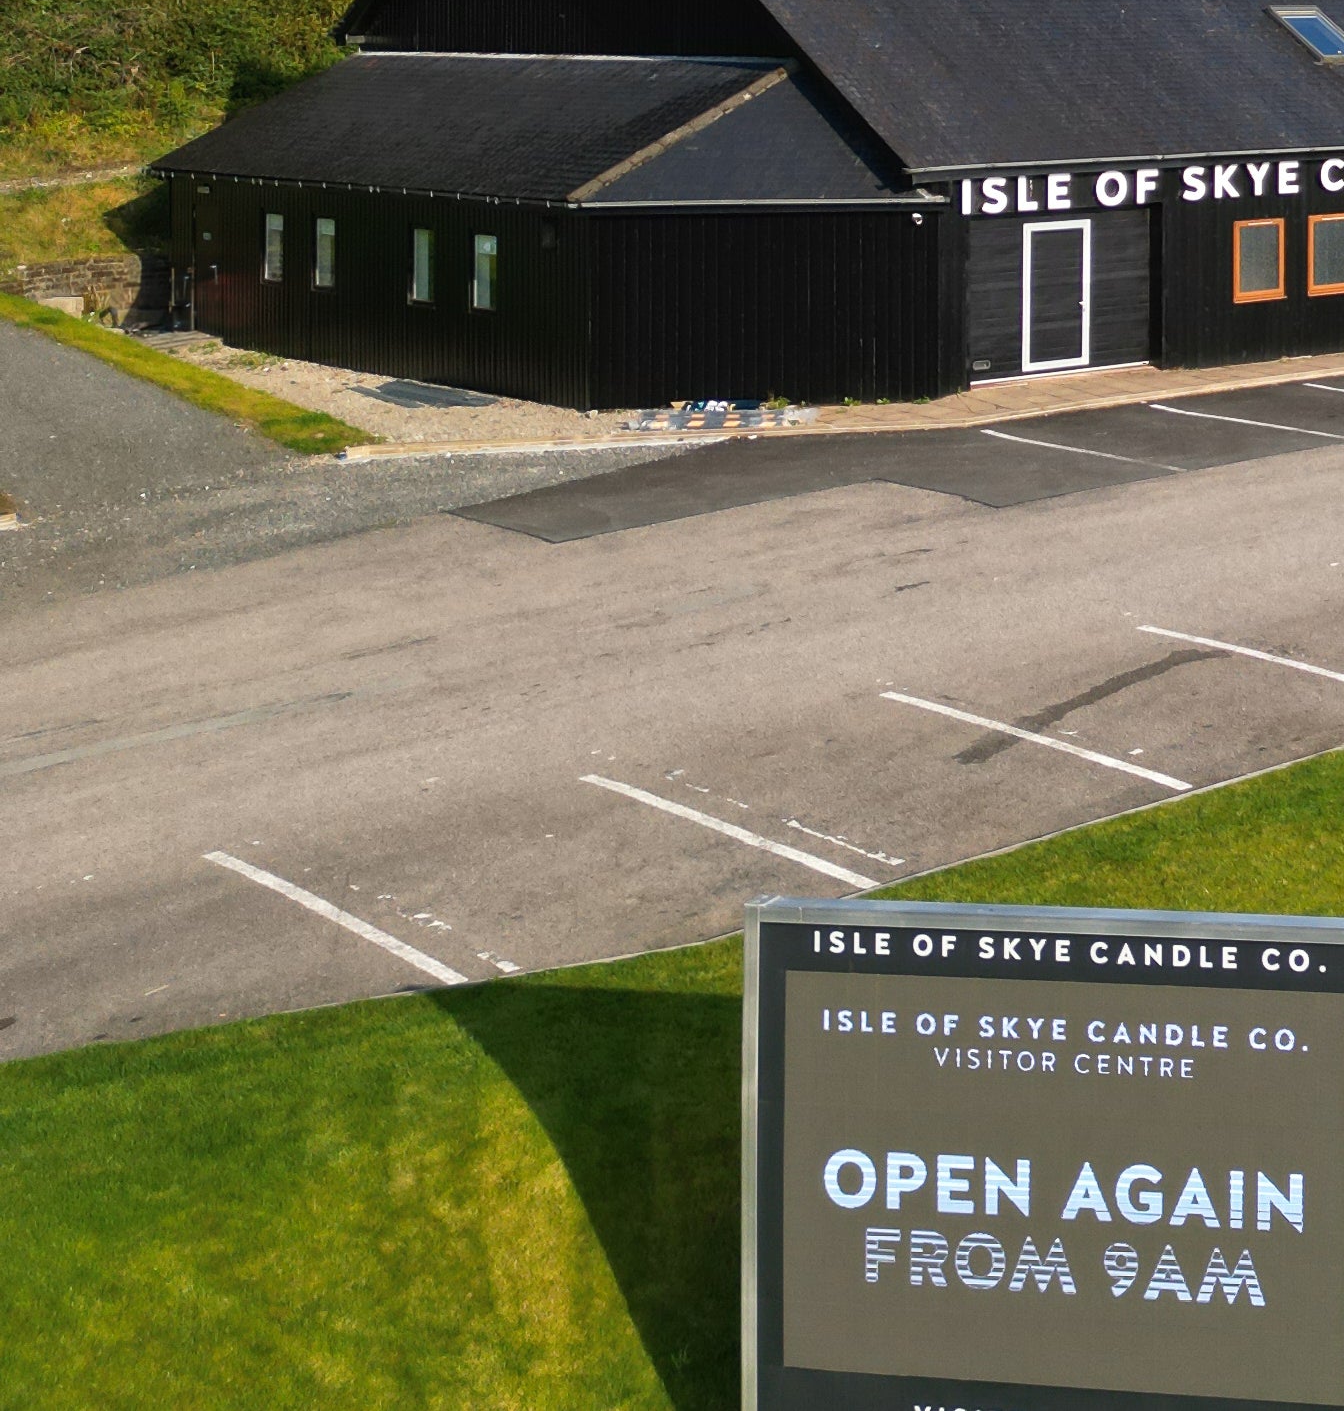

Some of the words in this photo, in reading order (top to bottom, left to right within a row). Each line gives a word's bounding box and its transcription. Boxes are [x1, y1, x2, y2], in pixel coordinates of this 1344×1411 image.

[961, 173, 1071, 215] ISLE
[1095, 169, 1159, 206] OF
[1182, 161, 1299, 202] SKYE
[813, 930, 891, 955] ISLE
[912, 934, 956, 957] OF
[978, 937, 1071, 962] SKYE
[1090, 941, 1238, 969] CANDLE
[1261, 948, 1327, 973] CO.
[823, 1009, 896, 1033] ISLE
[916, 1013, 959, 1036] OF
[978, 1015, 1067, 1040] SKYE
[1087, 1020, 1229, 1048] CANDLE
[1249, 1027, 1308, 1052] CO.
[933, 1047, 1056, 1071] VISITOR
[1074, 1053, 1194, 1078] CENTRE
[824, 1149, 1030, 1217] OPEN
[1061, 1162, 1304, 1233] AGAIN
[865, 1227, 1076, 1295] FROM
[1104, 1242, 1266, 1306] 9AM
